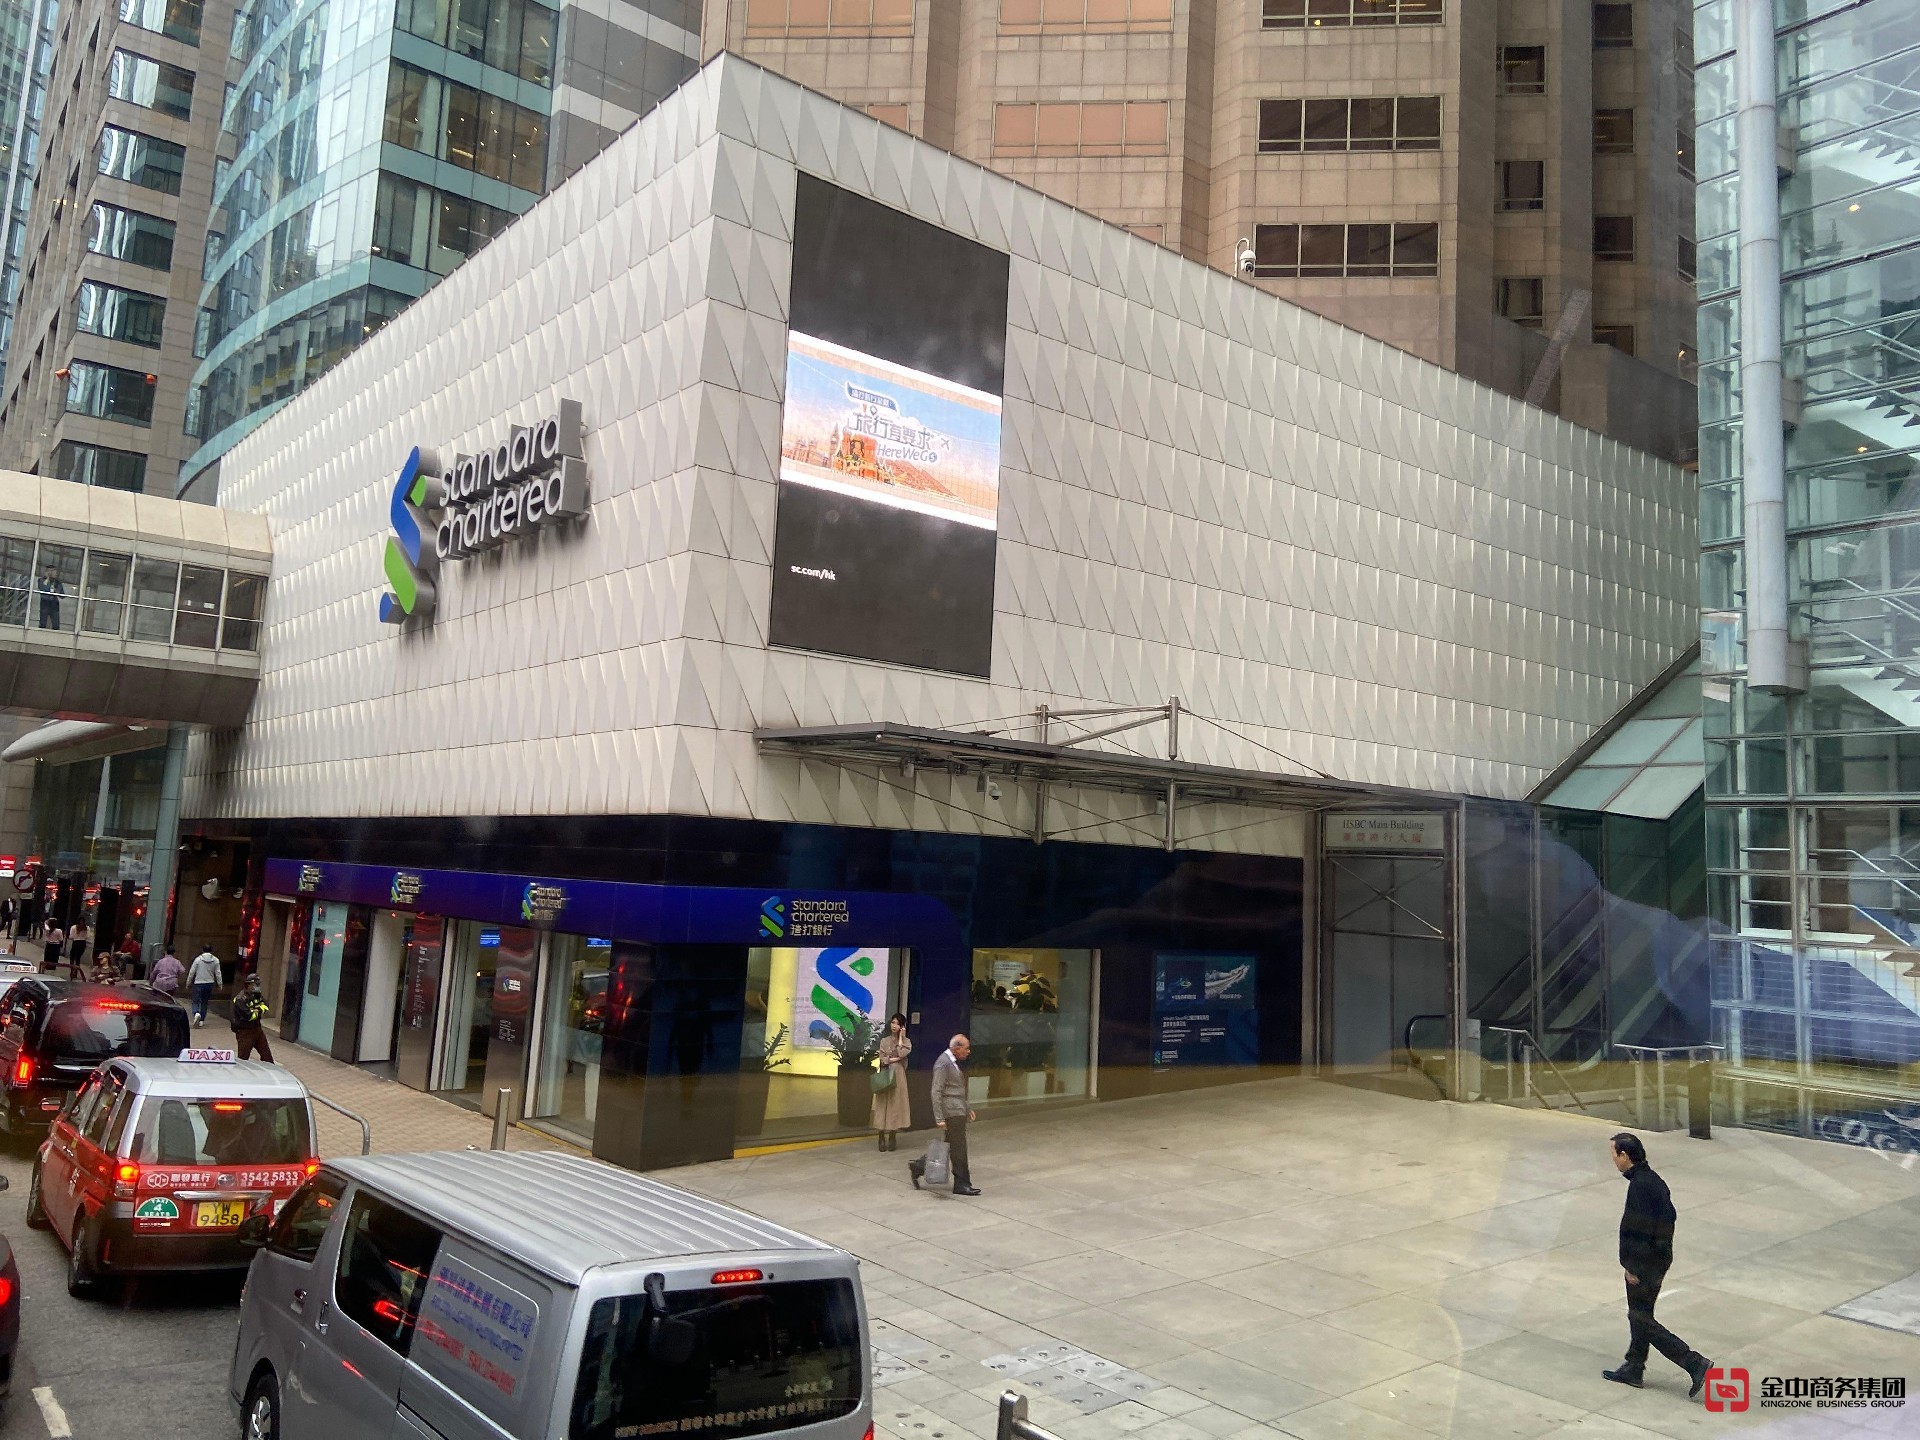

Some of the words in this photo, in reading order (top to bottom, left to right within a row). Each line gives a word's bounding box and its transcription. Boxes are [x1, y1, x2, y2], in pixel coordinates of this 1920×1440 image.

[439, 398, 575, 507] standard
[436, 455, 576, 559] chartered
[790, 564, 836, 581] sc.com/hk
[1343, 819, 1366, 829] HSBC
[1368, 820, 1388, 829] Main
[1390, 820, 1424, 831] Building
[791, 899, 847, 911] standard
[791, 911, 849, 922] chartered
[187, 1050, 232, 1061] TAXI
[241, 1172, 269, 1182] 3542
[272, 1171, 299, 1181] 5833
[153, 1203, 162, 1211] 4
[212, 1201, 231, 1215] YW
[200, 1214, 240, 1226] 9458
